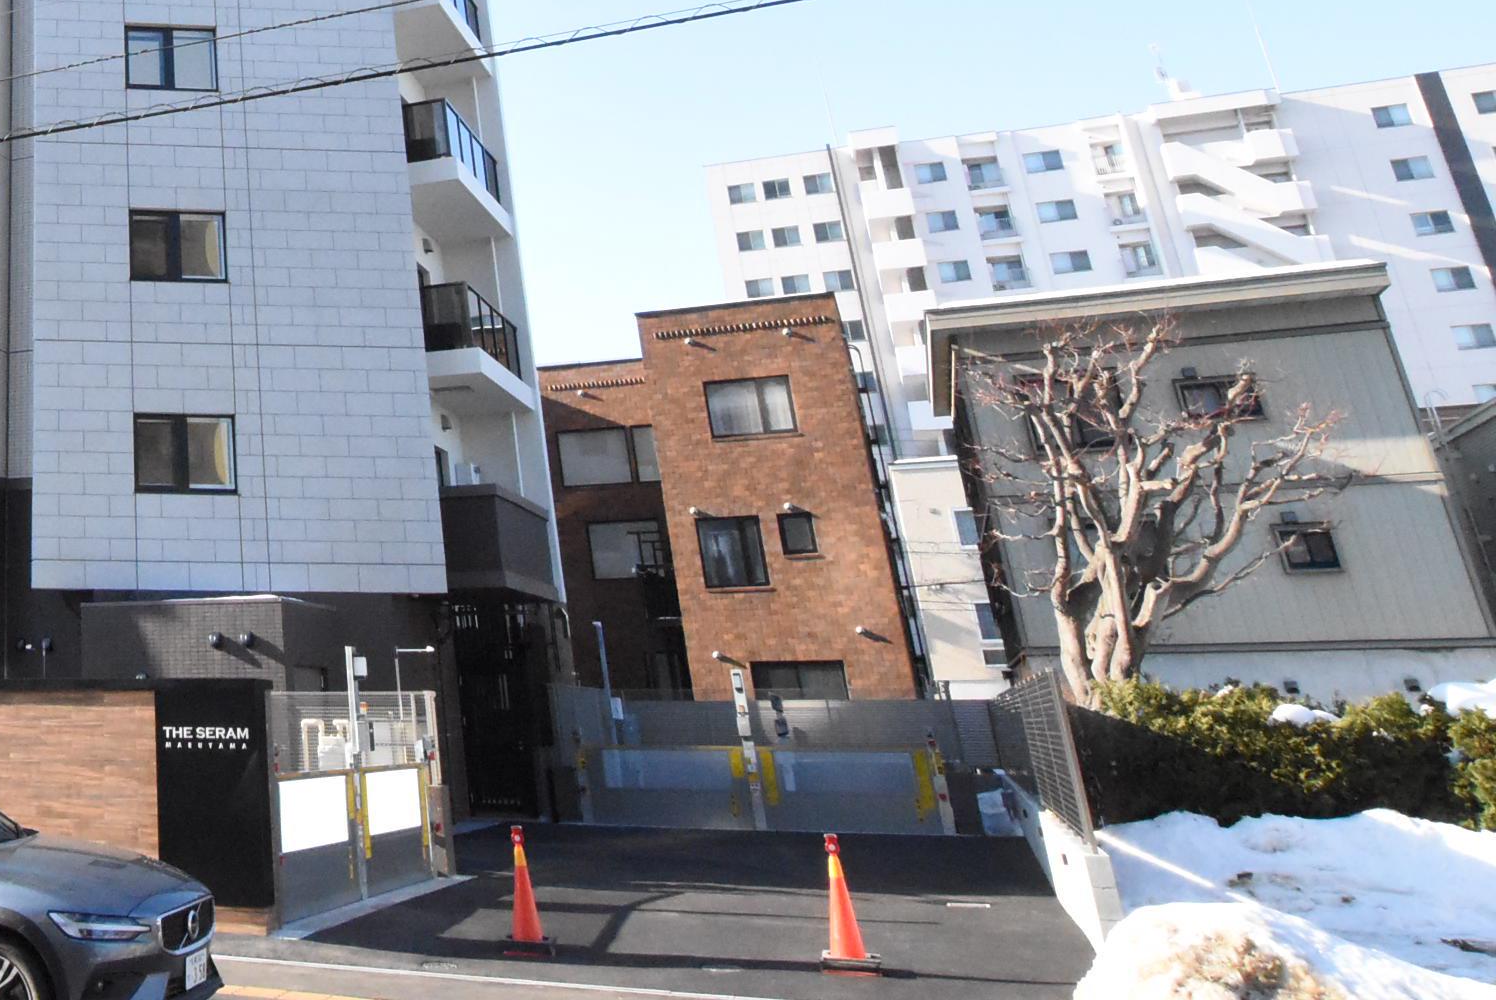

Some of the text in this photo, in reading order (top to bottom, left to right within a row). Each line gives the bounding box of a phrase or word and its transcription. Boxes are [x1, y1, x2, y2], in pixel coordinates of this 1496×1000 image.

[162, 726, 249, 740] THE SERAM
[165, 741, 248, 750] MARUYAMA
